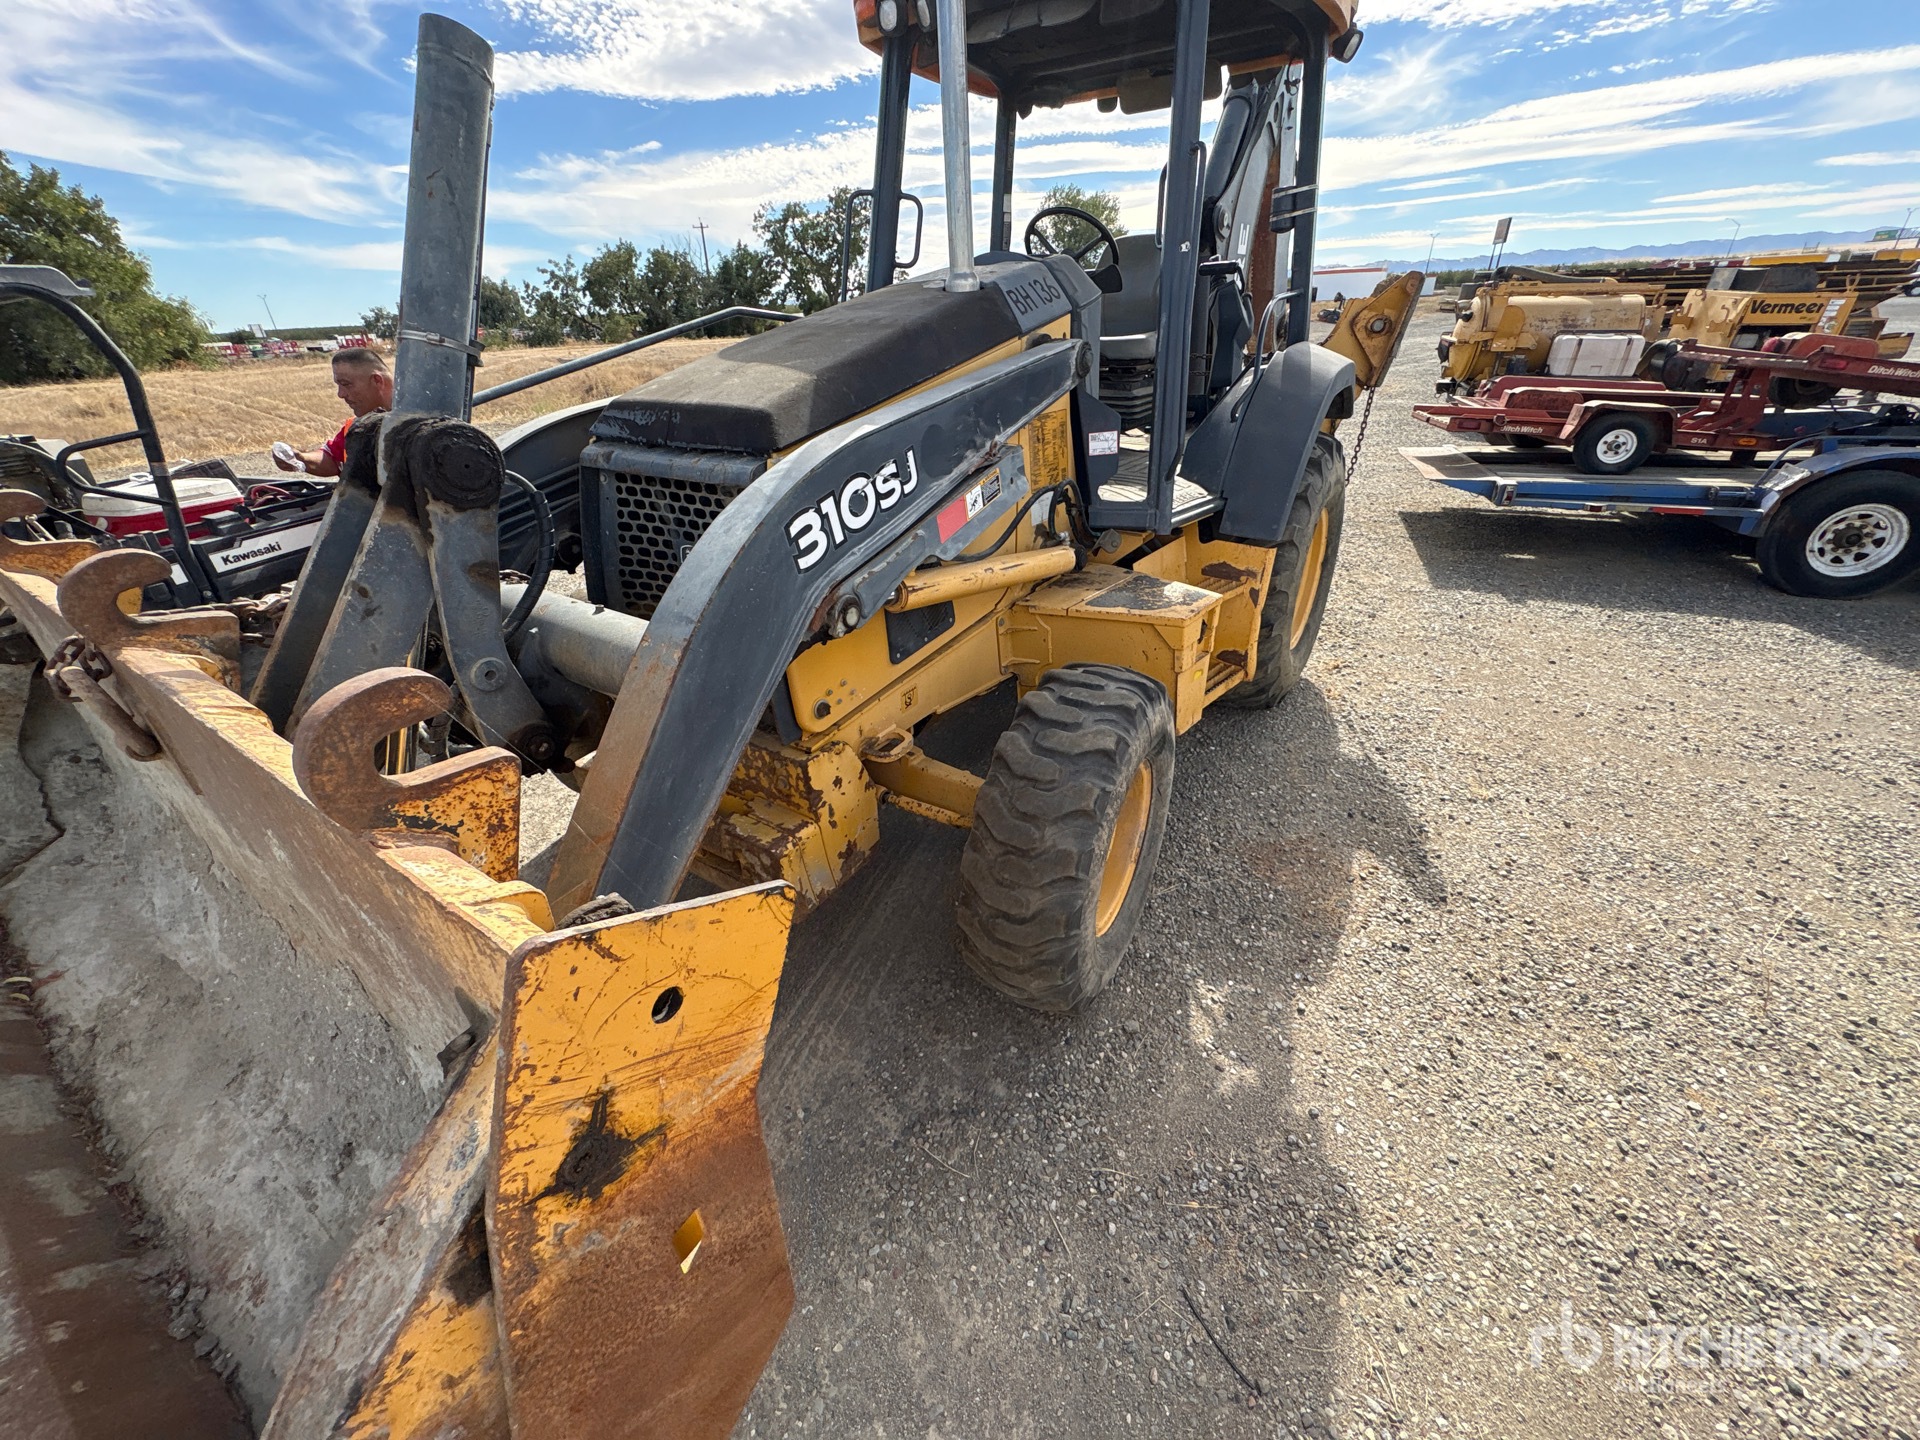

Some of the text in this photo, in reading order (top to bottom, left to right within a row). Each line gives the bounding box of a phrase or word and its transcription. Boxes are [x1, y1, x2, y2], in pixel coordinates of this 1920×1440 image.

[1006, 277, 1061, 315] BH 136
[1750, 299, 1825, 315] Vermeer
[1867, 365, 1896, 376] Ditch
[1520, 426, 1543, 434] Witch
[787, 448, 918, 571] 310SJ
[221, 541, 282, 566] Kawasaki
